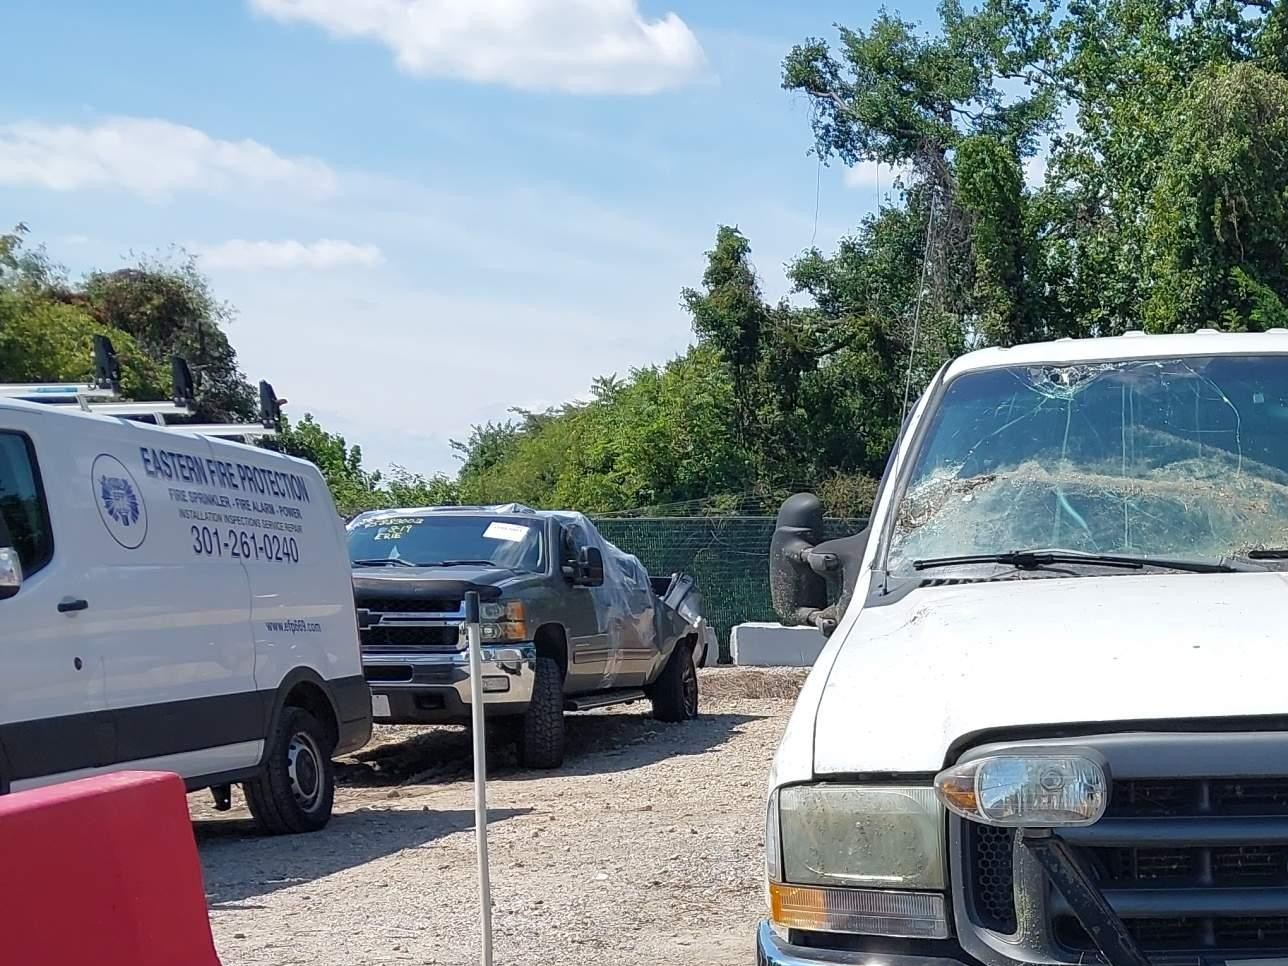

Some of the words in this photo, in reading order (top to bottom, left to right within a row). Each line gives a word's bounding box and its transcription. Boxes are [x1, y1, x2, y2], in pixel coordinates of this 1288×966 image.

[140, 447, 208, 486] EASTERN
[206, 459, 239, 488] FIRE
[237, 463, 310, 503] PROTECTION
[168, 488, 188, 503] FIRE
[188, 491, 232, 508] SPRINKLER
[235, 498, 252, 511] FIRE
[252, 501, 275, 515] ALARM
[179, 508, 222, 523] INSTALLATION
[223, 514, 261, 528] INSPECTIONS
[261, 518, 284, 531] SERVICE
[191, 525, 299, 563] 301-261-0240
